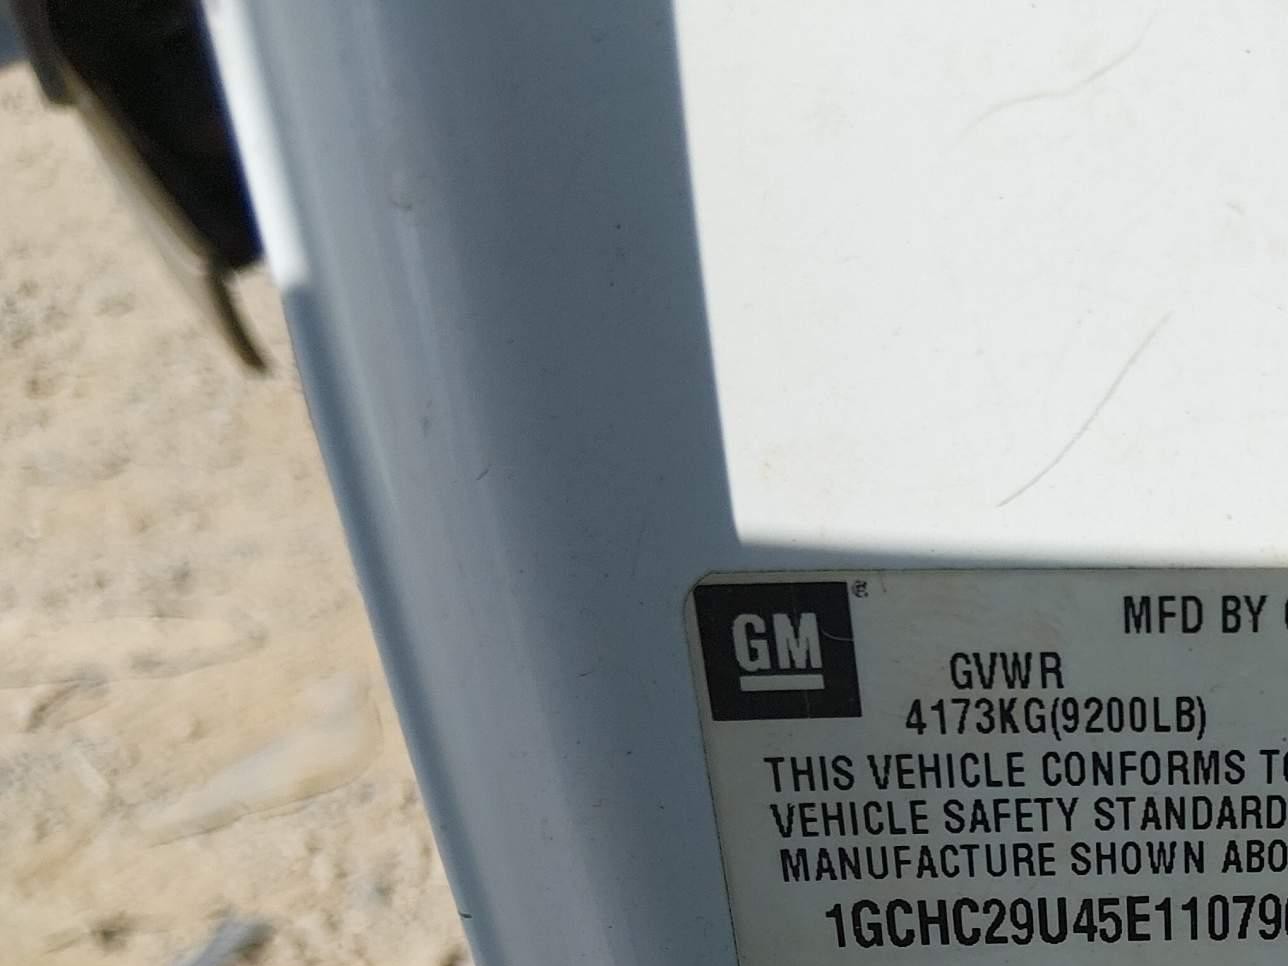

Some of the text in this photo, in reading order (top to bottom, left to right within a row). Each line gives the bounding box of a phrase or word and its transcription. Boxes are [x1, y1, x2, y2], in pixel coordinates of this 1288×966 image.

[1124, 595, 1203, 635] MFD
[1222, 595, 1266, 634] BY
[732, 612, 823, 672] GM
[950, 652, 1064, 690] GVWR
[906, 694, 1206, 740] 4173KG(9200LB)
[765, 755, 854, 793] THIS
[869, 751, 1025, 789] VEHICLE
[1042, 750, 1246, 788] CONFORMS
[772, 800, 929, 838] VEHICLE
[944, 798, 1078, 835] SAFETY
[781, 843, 1055, 882] MANUFACTURE
[1071, 840, 1204, 876] SHOWN
